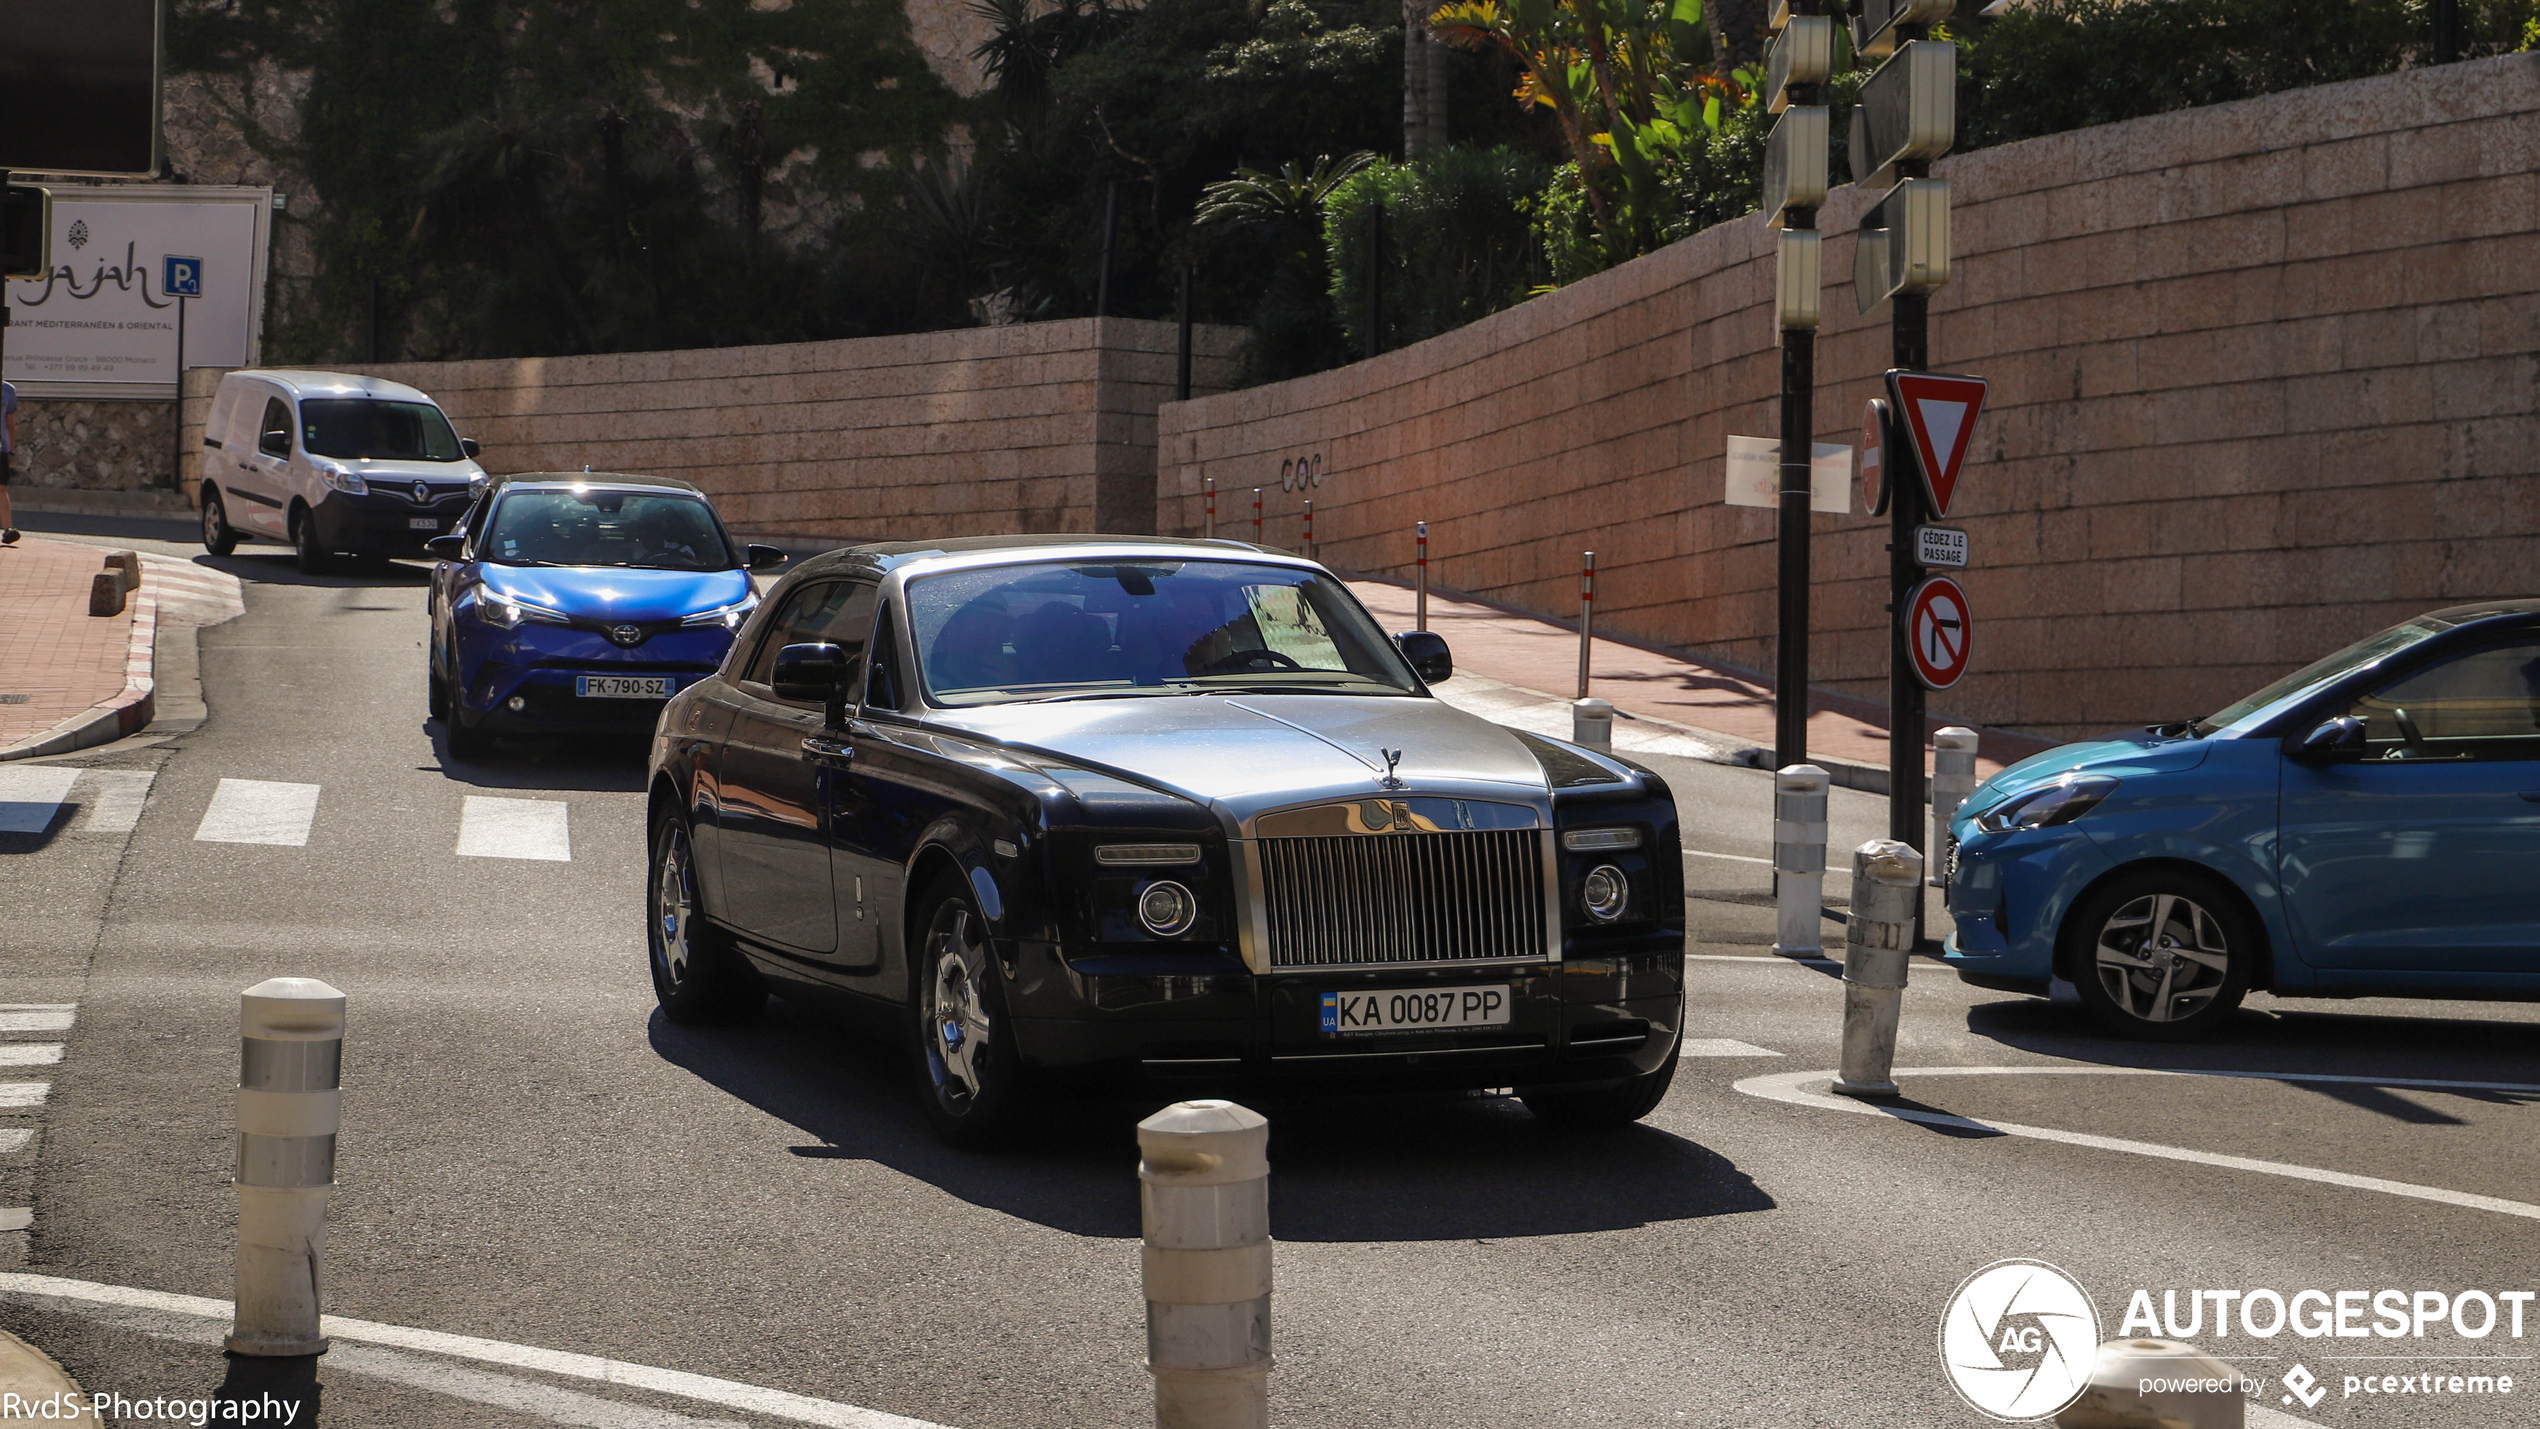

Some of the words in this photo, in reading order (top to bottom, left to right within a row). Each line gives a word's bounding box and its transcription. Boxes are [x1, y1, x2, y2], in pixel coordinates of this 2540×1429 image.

[174, 263, 192, 288] P
[9, 320, 34, 328] RANT
[36, 319, 115, 329] MÉDITERRANÉEN
[117, 321, 124, 329] &
[126, 321, 173, 330] ORIENTAL
[25, 354, 62, 362] Princesse
[65, 355, 88, 363] Grace
[1923, 530, 1950, 546] CÉDEZ
[1953, 535, 1963, 547] LE
[1924, 547, 1961, 563] PASSAGE
[587, 679, 664, 694] FK-790-SZ
[1340, 996, 1382, 1026] KA
[1390, 992, 1455, 1024] 0087
[1462, 990, 1502, 1021] PP
[1322, 1017, 1336, 1026] UA
